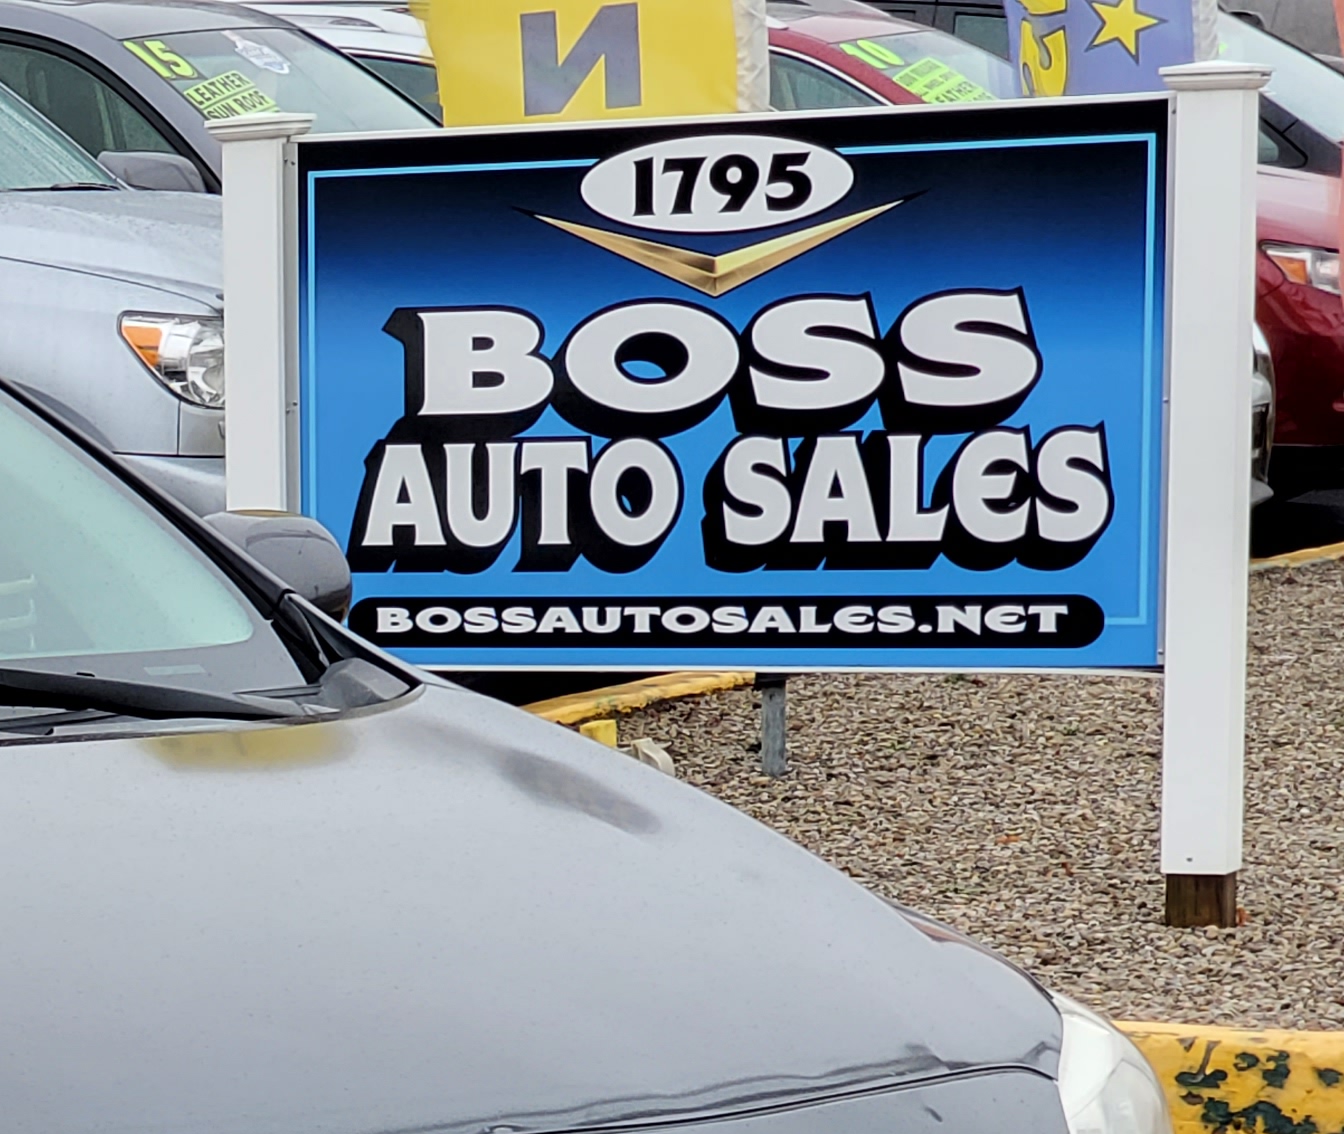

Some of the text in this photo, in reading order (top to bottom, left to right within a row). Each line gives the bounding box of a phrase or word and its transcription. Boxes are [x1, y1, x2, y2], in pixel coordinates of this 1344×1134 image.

[123, 40, 198, 79] 15
[839, 39, 905, 69] 10
[186, 72, 251, 106] LEATHER
[206, 90, 272, 119] SUN ROOF
[633, 152, 813, 217] 1795
[418, 292, 1040, 416] BOSS
[362, 430, 1110, 547] AUTO SALES
[375, 604, 1069, 635] BOSSAUTOSALES.NET
